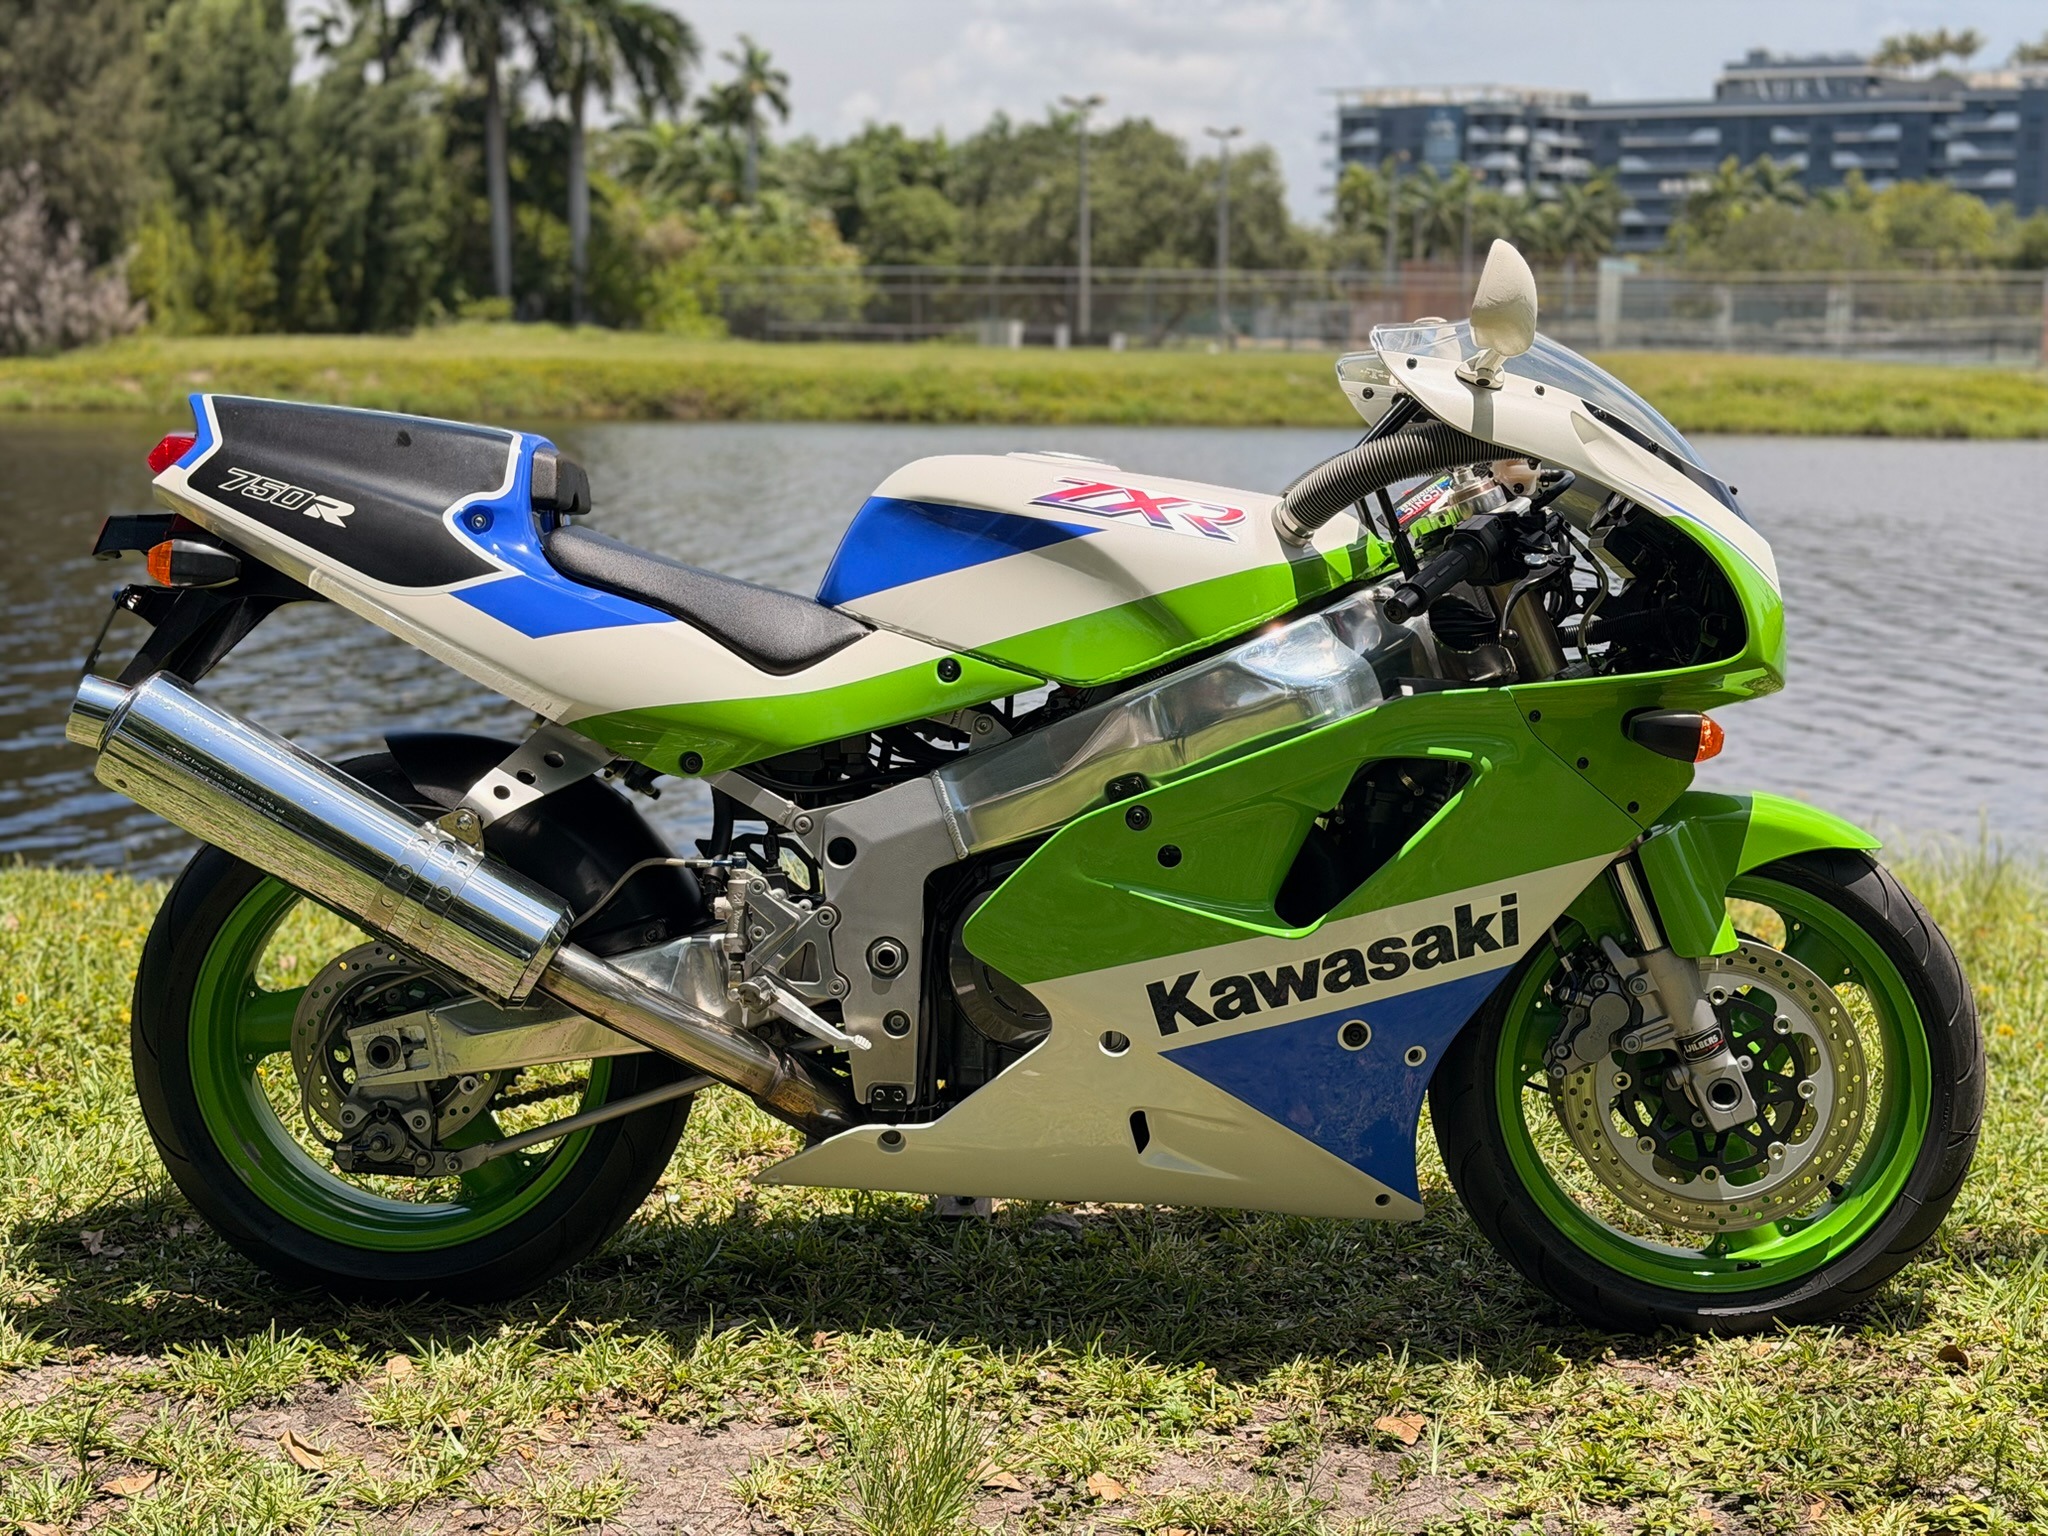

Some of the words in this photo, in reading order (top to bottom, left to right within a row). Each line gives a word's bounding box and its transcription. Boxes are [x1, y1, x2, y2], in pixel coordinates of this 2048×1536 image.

[218, 466, 356, 529] 750R
[1027, 477, 1246, 543] ZXR
[1404, 486, 1444, 516] ICONIC
[1145, 891, 1520, 1037] Kawasaki
[1683, 1034, 1719, 1053] WILBERS
